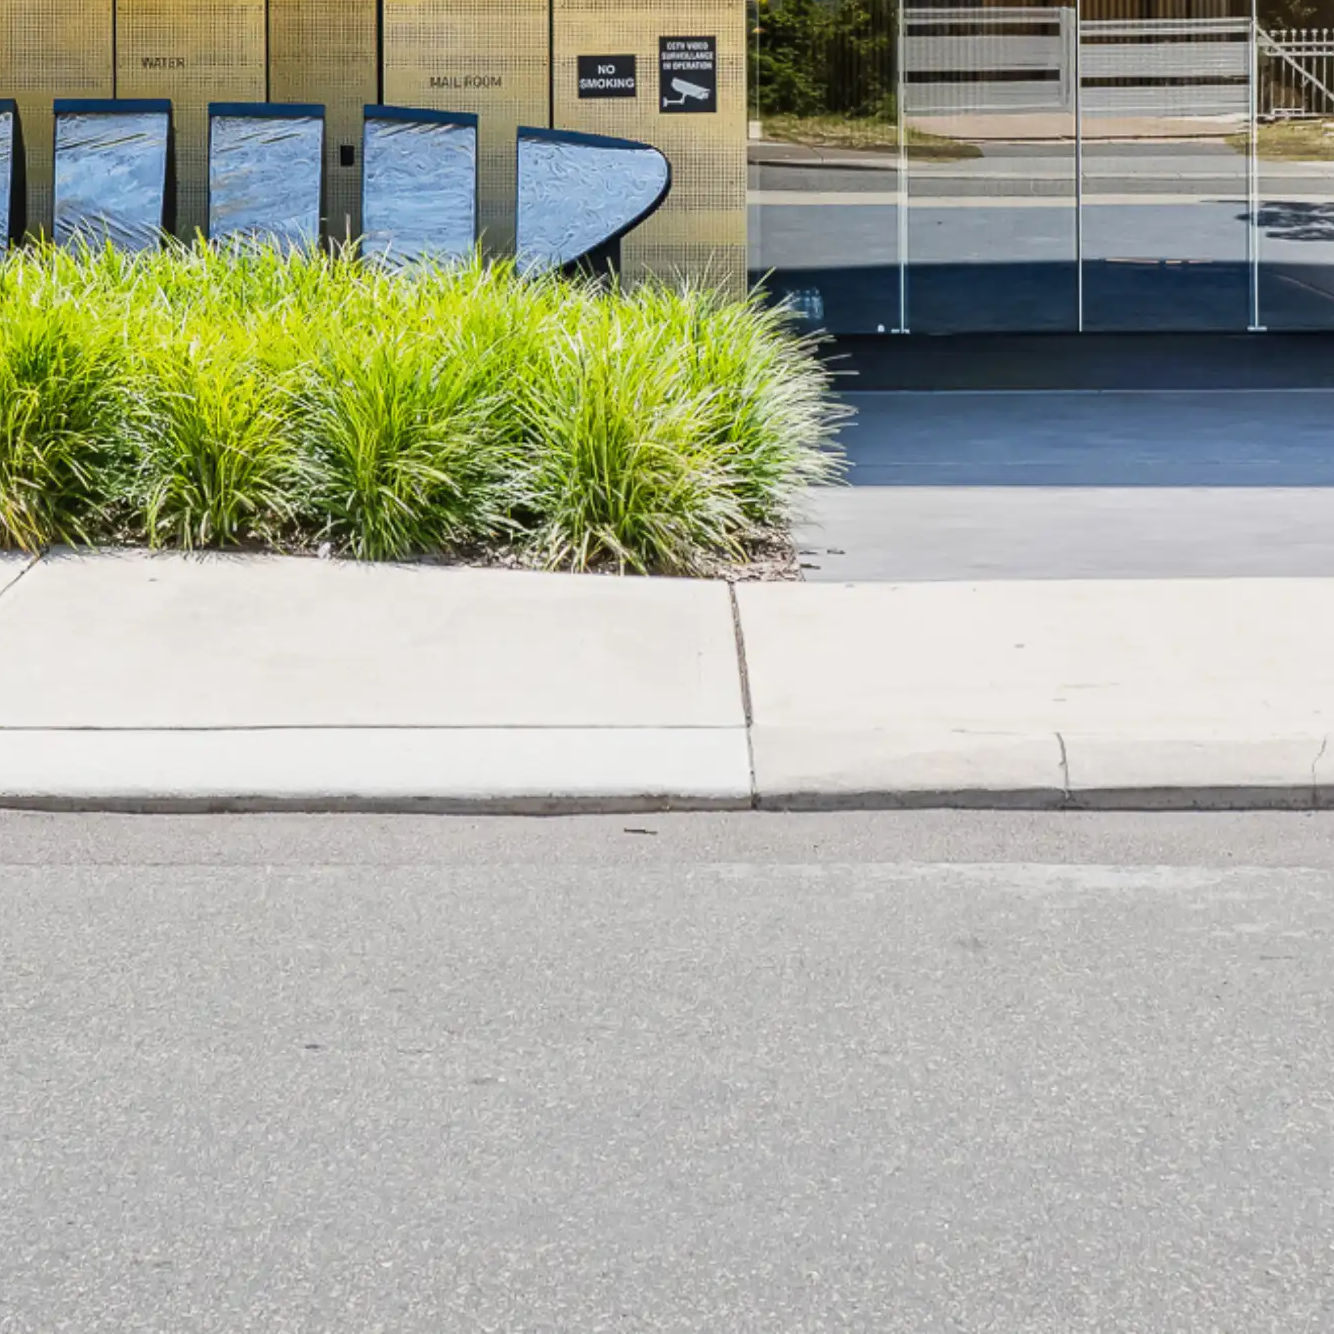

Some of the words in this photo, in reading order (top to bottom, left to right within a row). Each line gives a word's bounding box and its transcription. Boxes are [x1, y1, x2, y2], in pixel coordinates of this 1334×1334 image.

[141, 57, 185, 69] WATER
[597, 65, 615, 74] NO
[430, 76, 462, 88] MAIL
[464, 75, 502, 87] ROOM
[579, 78, 635, 89] SMOKING
